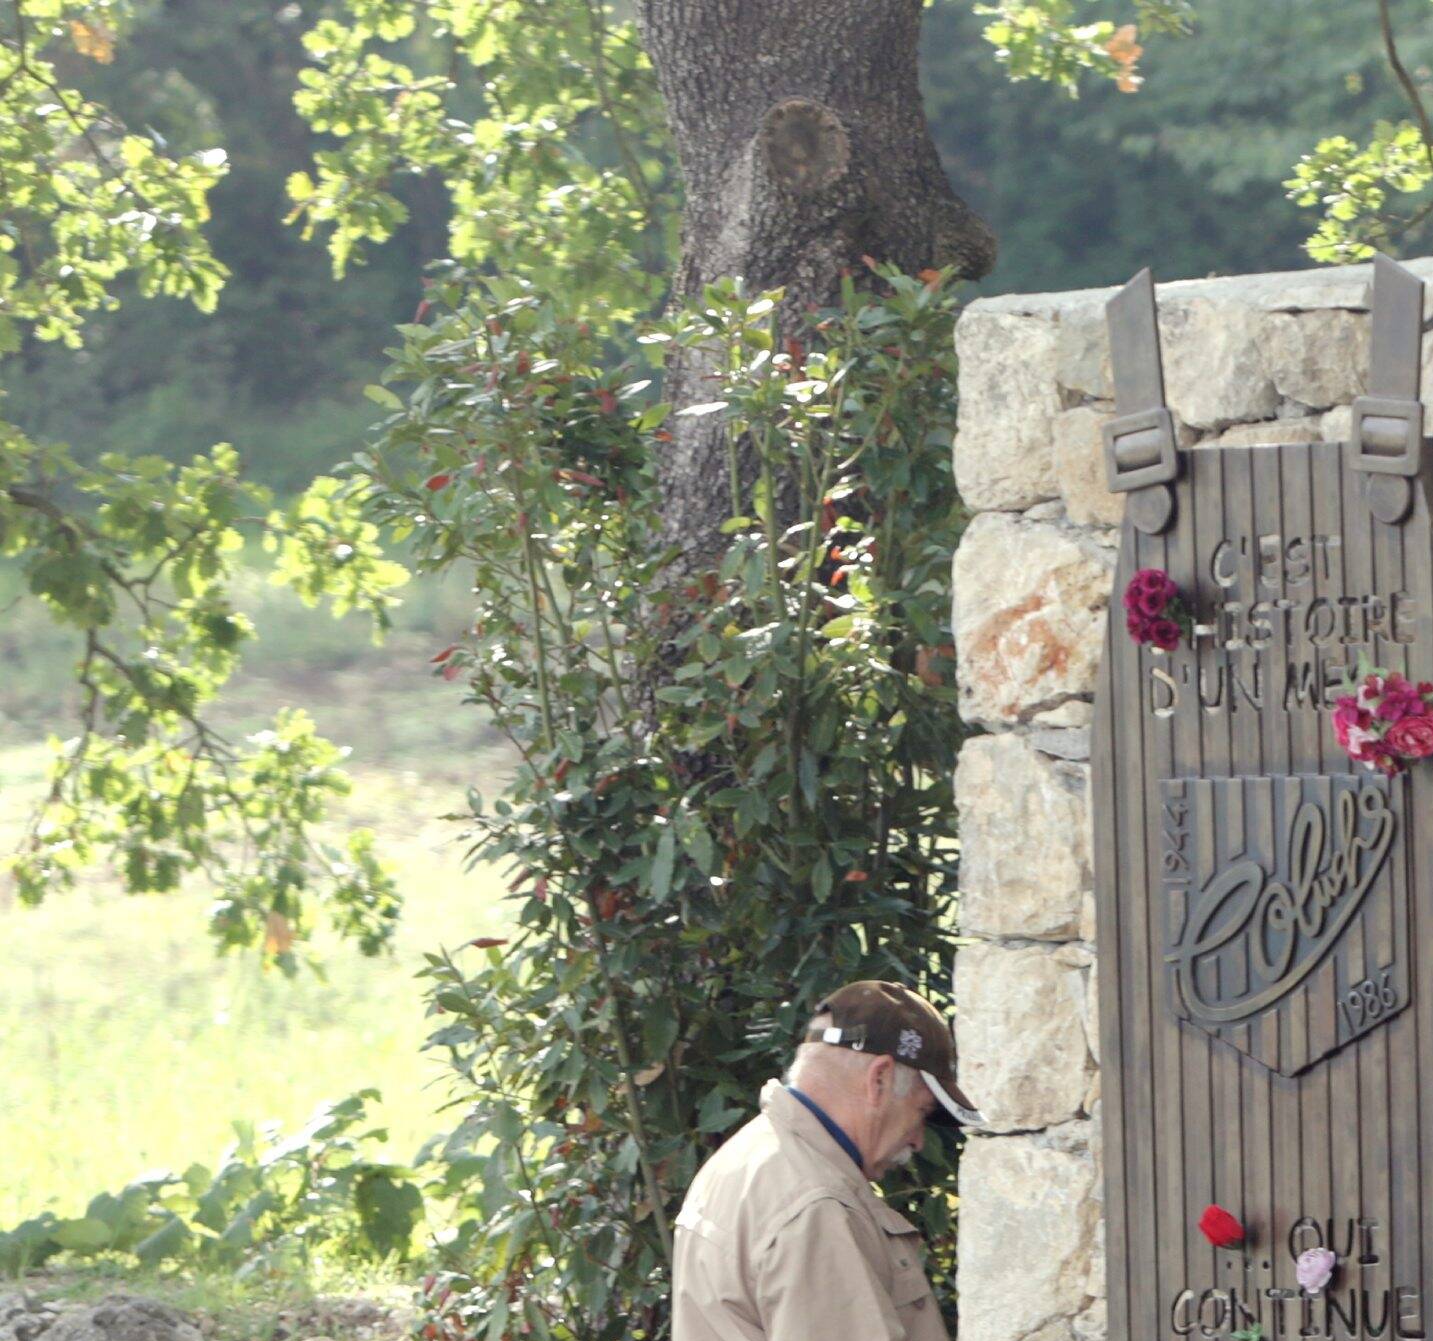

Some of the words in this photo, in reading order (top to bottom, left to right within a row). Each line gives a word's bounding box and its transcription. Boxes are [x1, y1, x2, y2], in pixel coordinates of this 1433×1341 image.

[1210, 533, 1342, 590] C'EST
[1190, 590, 1417, 656] HISTOIRE
[1150, 661, 1264, 719] D'UN
[1283, 657, 1360, 713] ME
[1162, 802, 1192, 885] 1944
[1337, 971, 1398, 1031] 1986
[1170, 1285, 1426, 1341] CONTINUE
